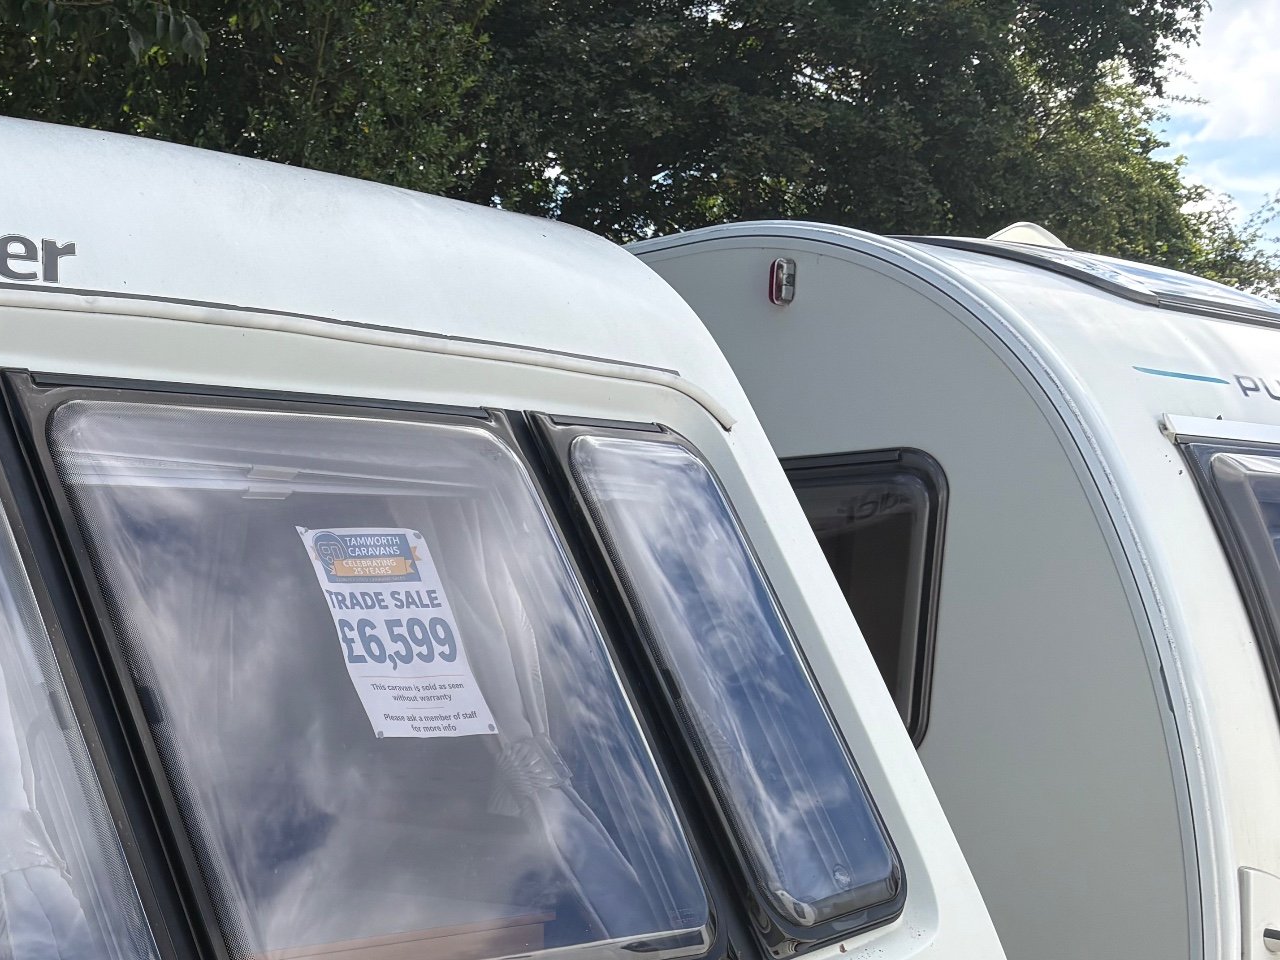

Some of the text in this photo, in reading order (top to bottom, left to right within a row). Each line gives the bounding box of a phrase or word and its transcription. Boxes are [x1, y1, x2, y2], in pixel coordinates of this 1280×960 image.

[344, 536, 400, 546] TAMWORTH
[348, 546, 400, 556] CARAVANS
[342, 559, 397, 568] CELEBRATING
[353, 567, 392, 575] 25 YEARS
[325, 589, 442, 610] TRADE SALE
[337, 616, 457, 671] £6,599
[371, 683, 387, 691] This
[421, 683, 437, 692] sold
[447, 682, 465, 690] seen
[392, 693, 452, 702] without warranty
[383, 713, 405, 721] Please
[406, 714, 417, 722] ask
[424, 714, 451, 722] member
[453, 712, 461, 720] of
[461, 711, 478, 719] staff
[411, 723, 421, 732] for
[441, 723, 457, 732] info
